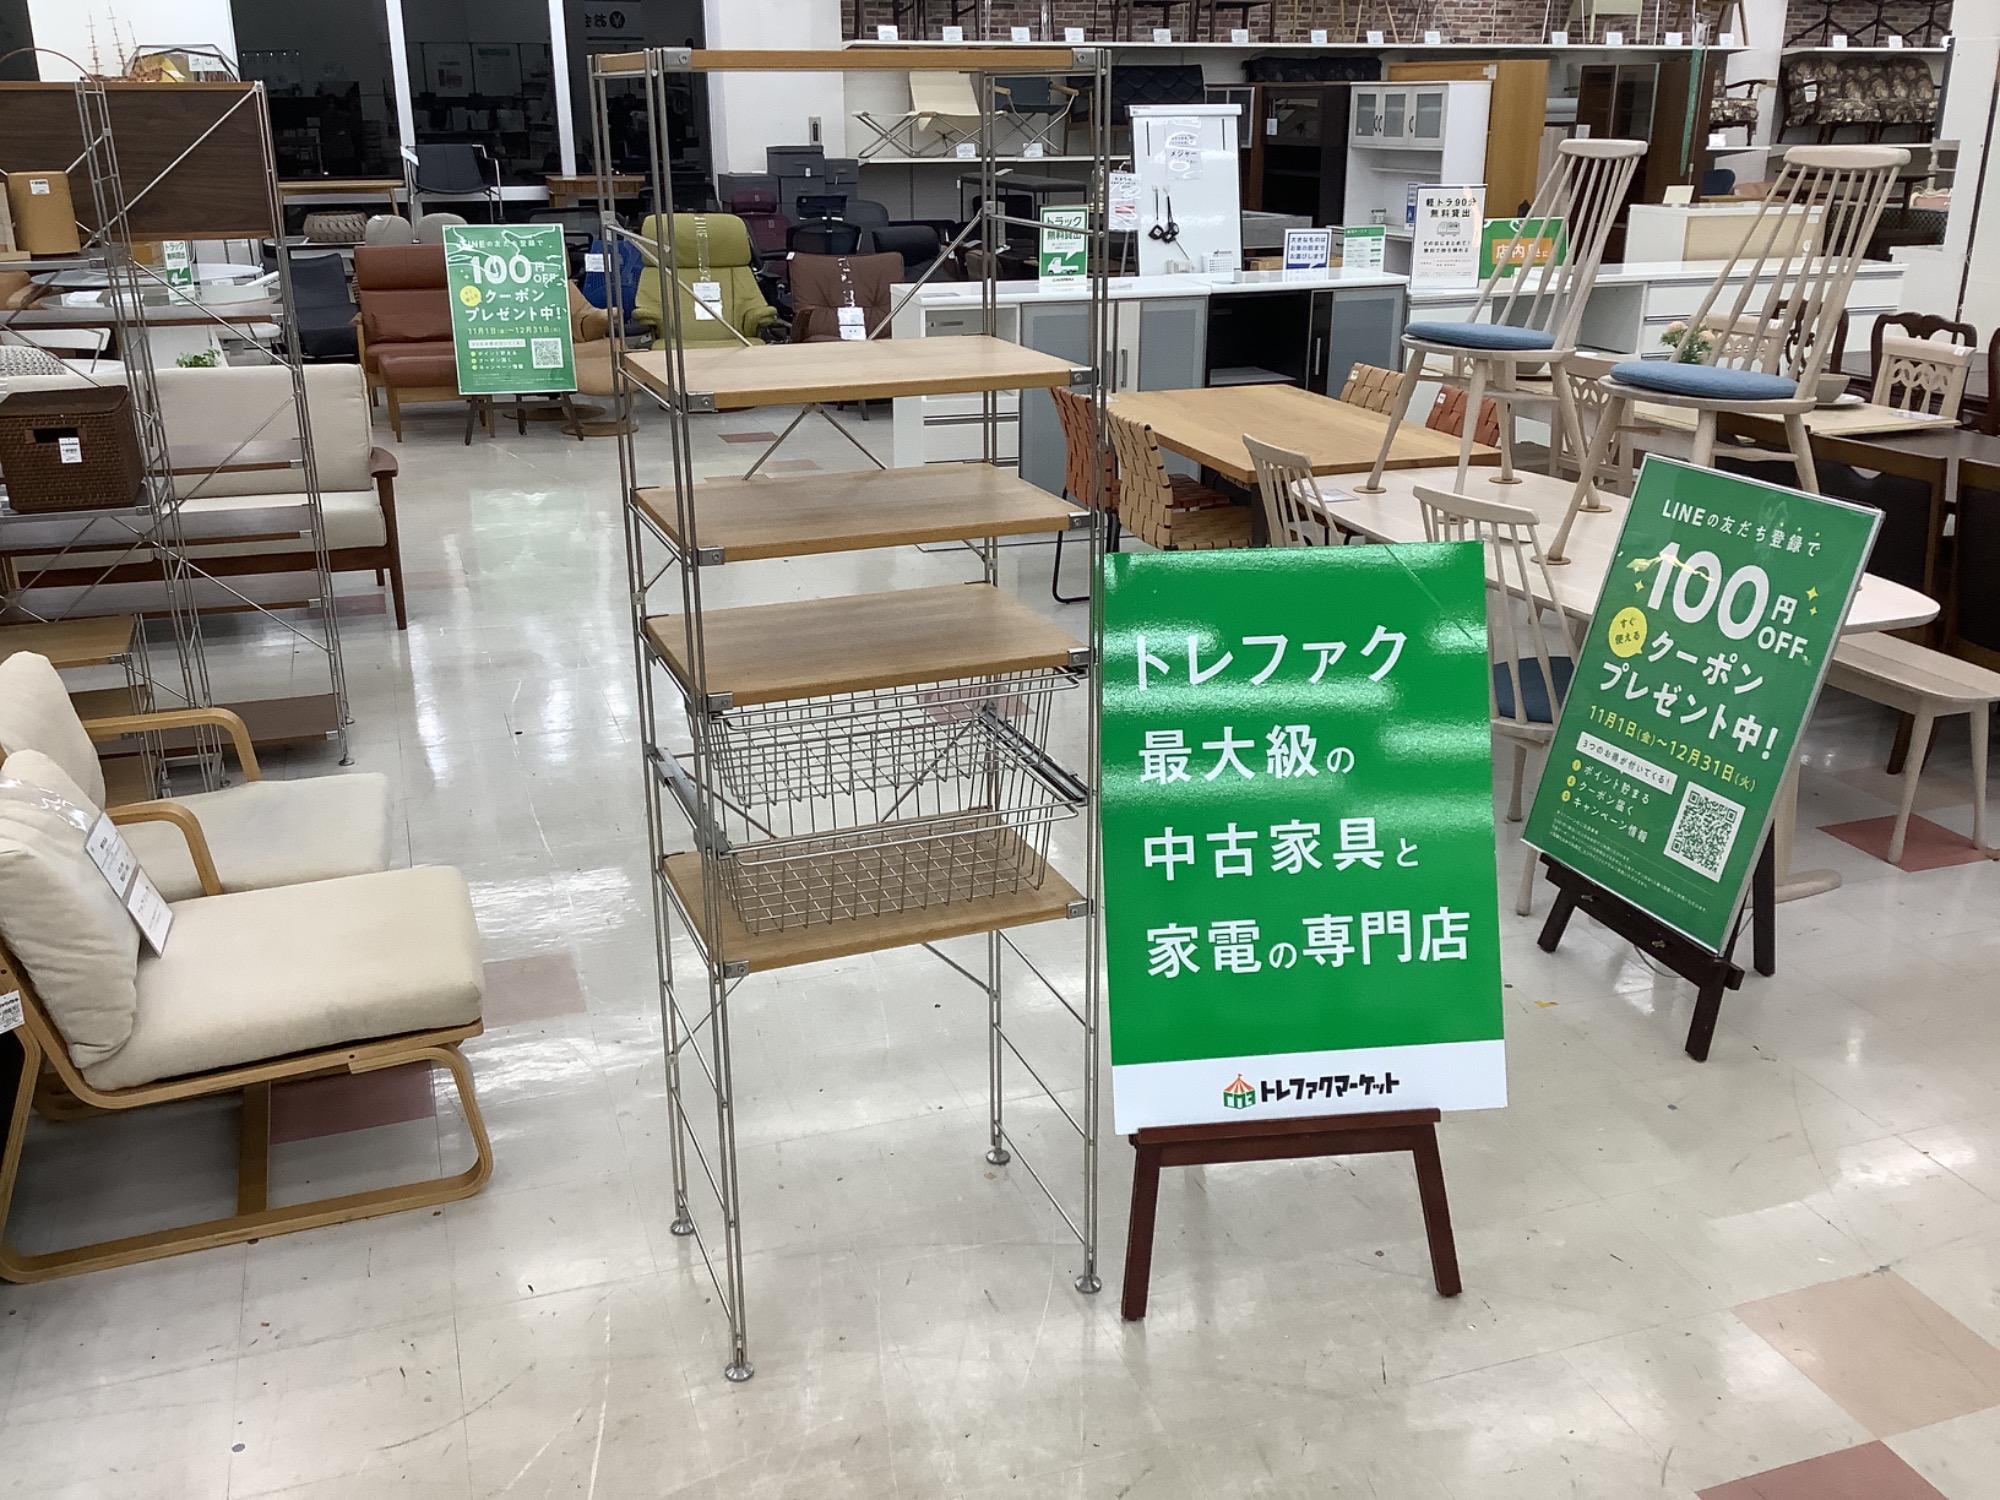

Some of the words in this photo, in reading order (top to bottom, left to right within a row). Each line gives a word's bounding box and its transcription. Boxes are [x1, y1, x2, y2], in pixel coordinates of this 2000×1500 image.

[1426, 197, 1476, 207] 軽トラ90分
[1430, 209, 1470, 218] 無料貸出
[1048, 216, 1082, 227] トラック
[465, 305, 561, 322] プレゼント中!
[485, 288, 544, 303] クーポン
[1662, 499, 1820, 557] LINEの友だち登録で
[1615, 631, 1640, 645] 使える
[1619, 616, 1638, 628] すぐ
[1136, 625, 1407, 692] トレファク
[1758, 626, 1808, 659] OFF
[1648, 630, 1763, 695] クーポン
[1600, 661, 1779, 760] プレゼント中!
[1139, 724, 1355, 784] 最大級の
[1584, 765, 1650, 804] ポイント貯まる
[1573, 796, 1648, 843] キャンペーン情報
[1144, 817, 1419, 881] 中古家具と
[1147, 906, 1470, 979] 家電の専門店
[1261, 1072, 1400, 1103] トレファクマーケット
